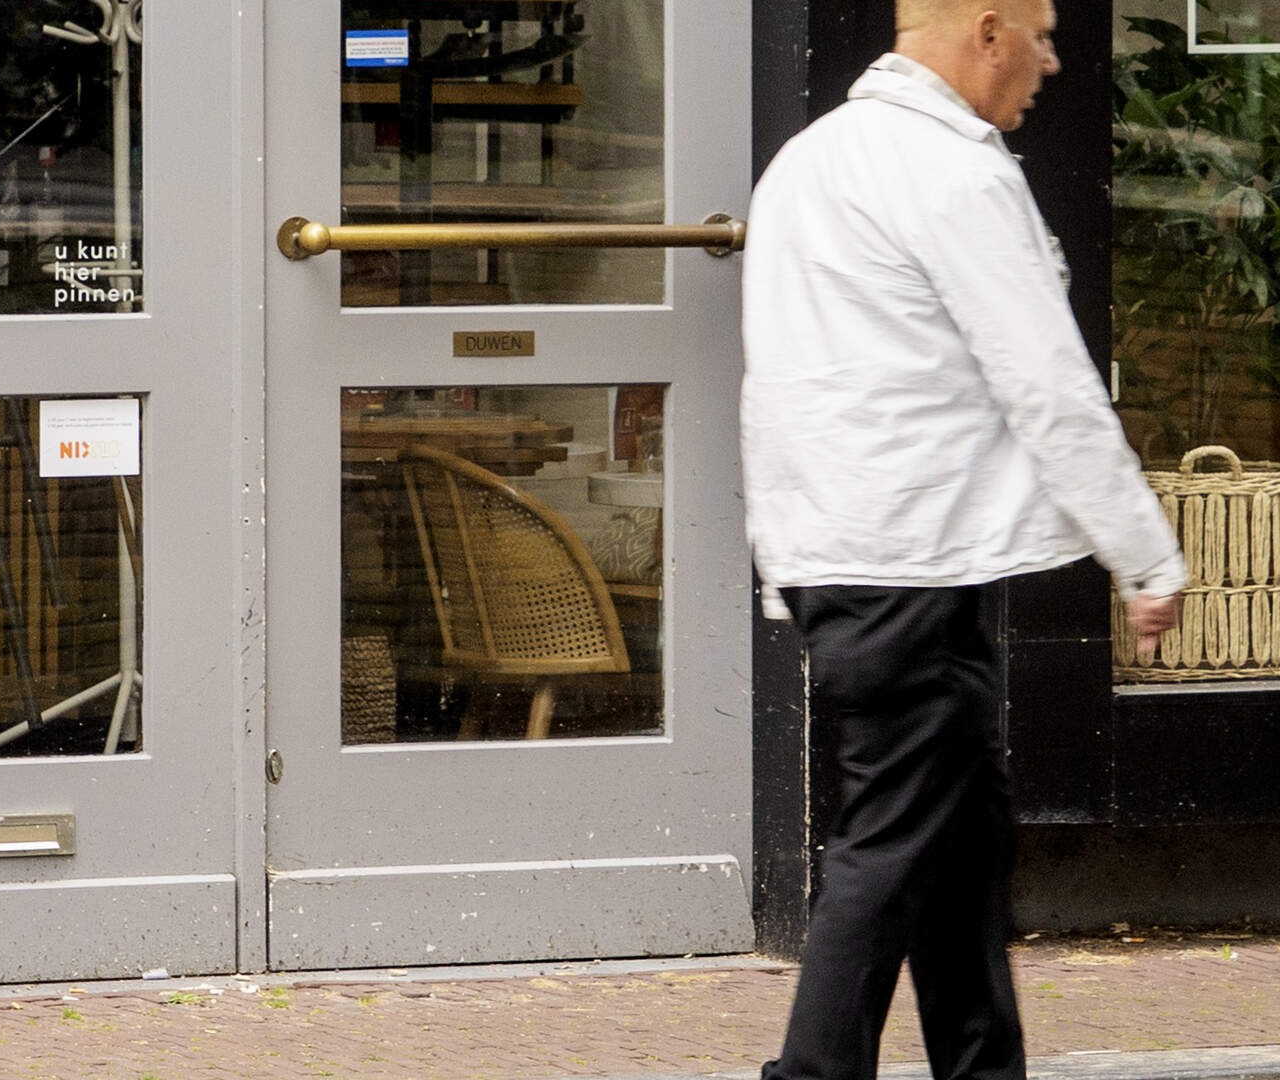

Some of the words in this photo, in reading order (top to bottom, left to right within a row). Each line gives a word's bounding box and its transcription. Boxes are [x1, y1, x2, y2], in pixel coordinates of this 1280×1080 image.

[55, 245, 67, 259] u
[78, 240, 128, 259] kunt
[55, 261, 101, 281] hier
[55, 284, 135, 307] pinnen
[465, 335, 521, 352] DUWEN
